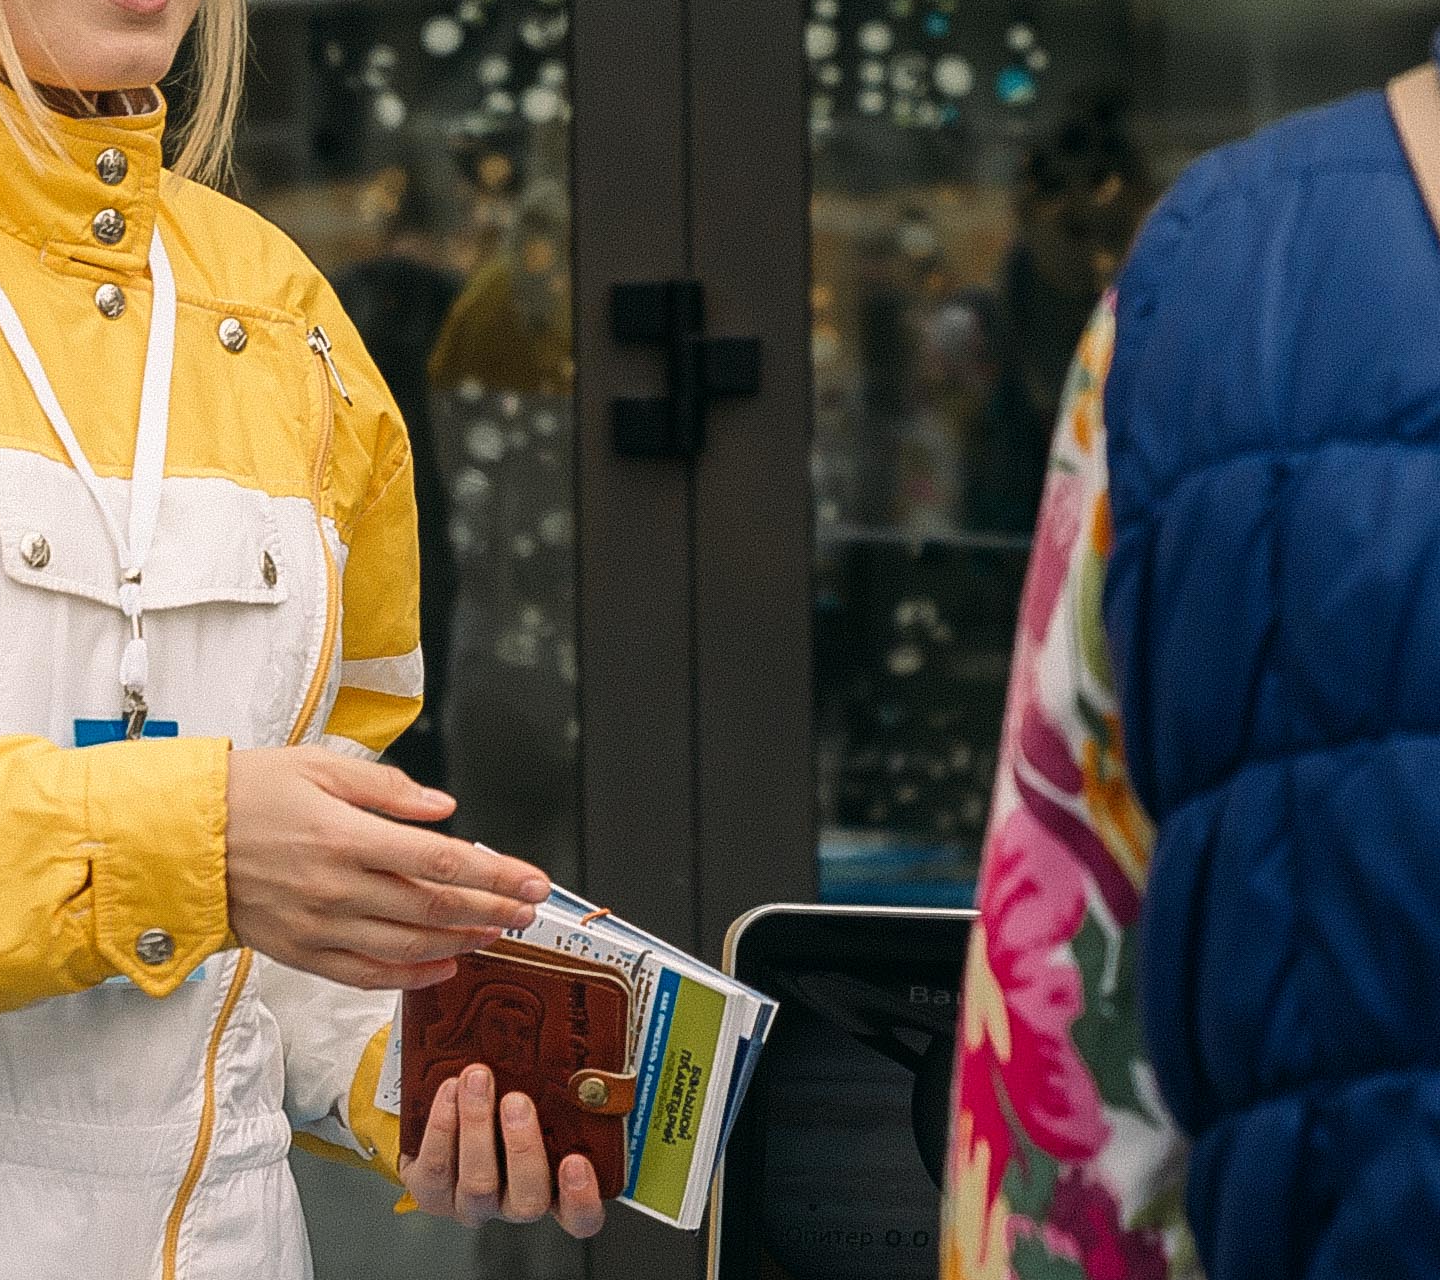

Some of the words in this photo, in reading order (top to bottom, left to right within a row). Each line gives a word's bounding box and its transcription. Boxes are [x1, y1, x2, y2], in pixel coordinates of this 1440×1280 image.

[909, 984, 961, 1006] Ва
[661, 1049, 692, 1145] ПЛАНЕТАРИЙ
[677, 1065, 702, 1140] БОЛЬШОЙ
